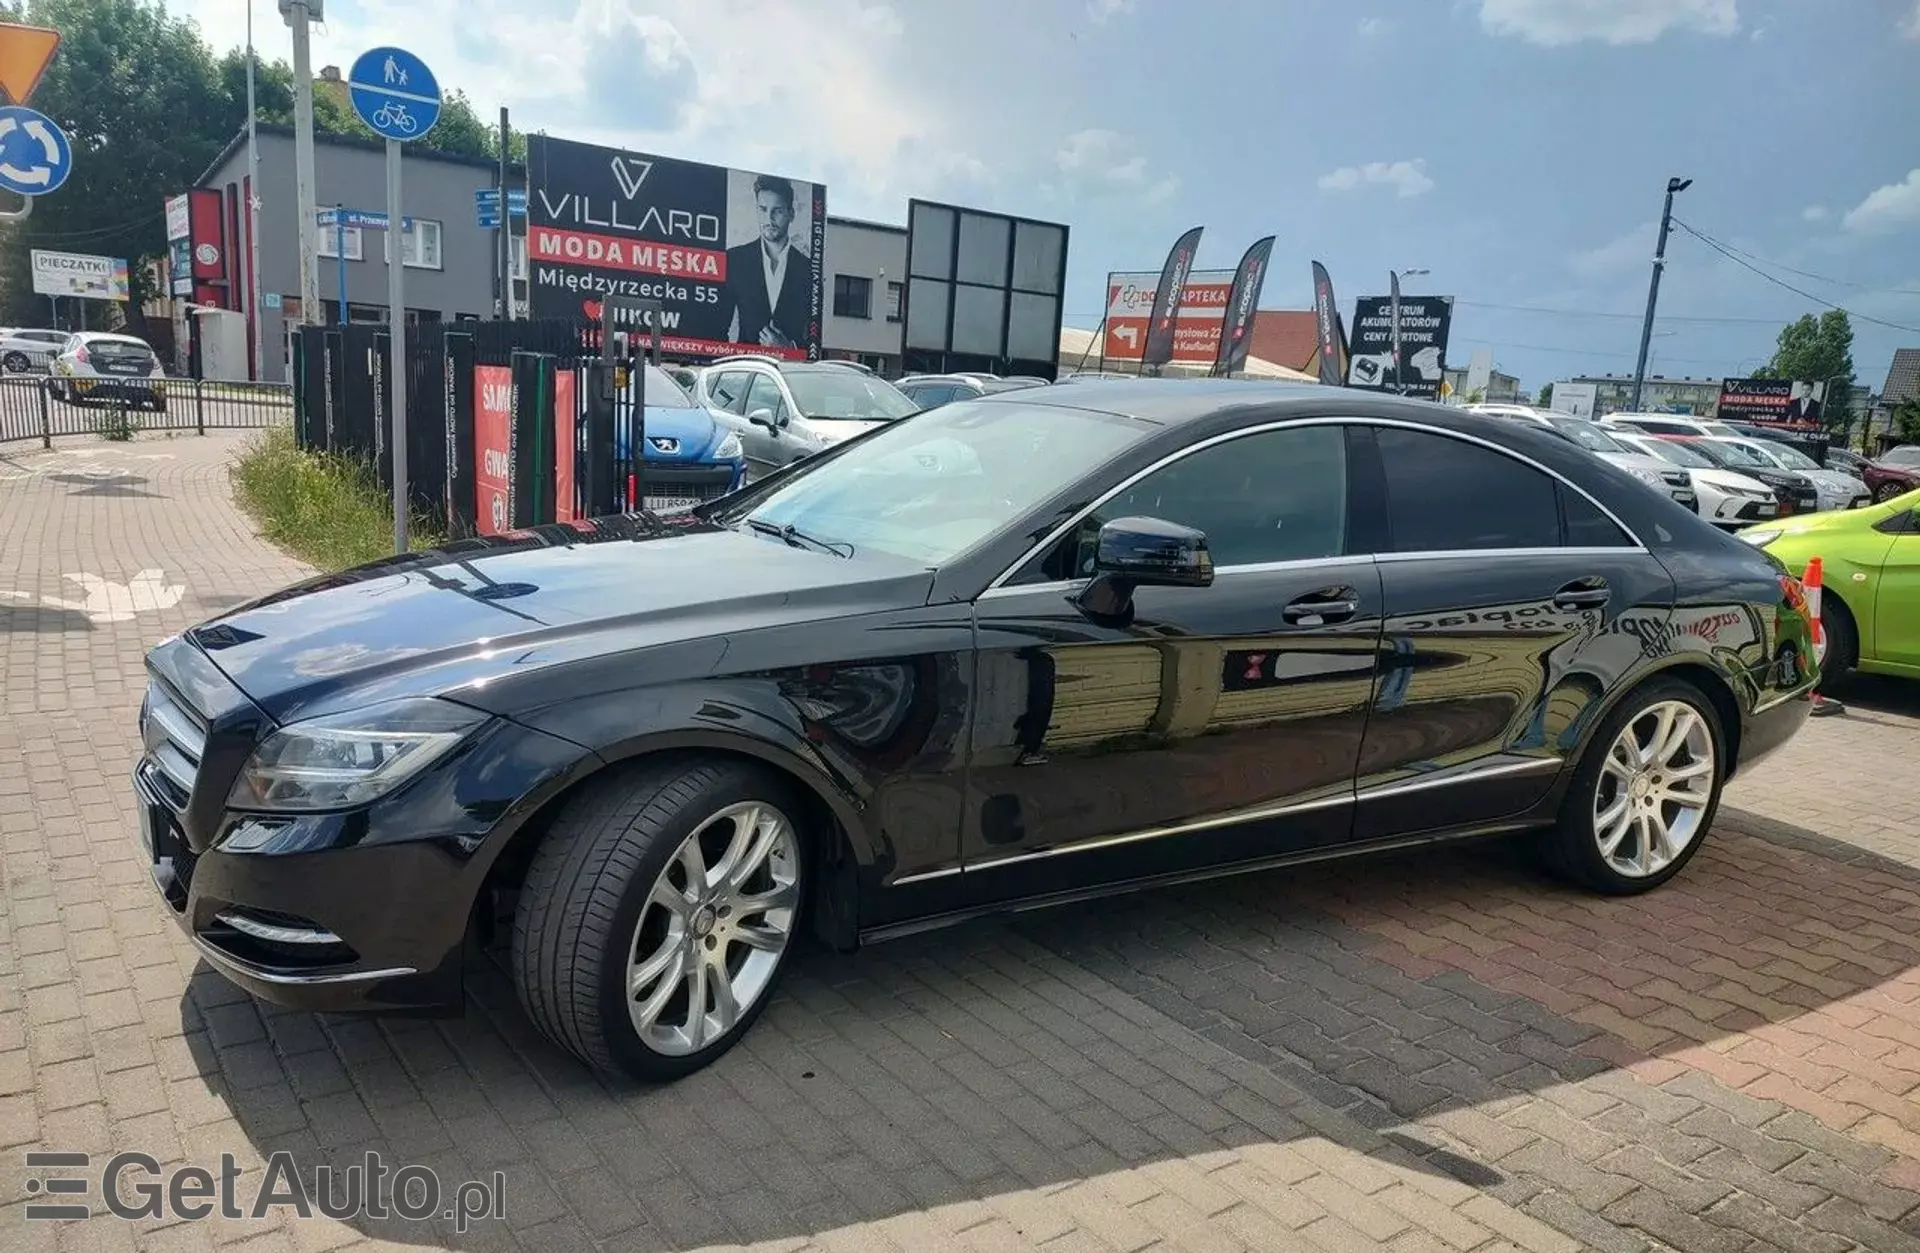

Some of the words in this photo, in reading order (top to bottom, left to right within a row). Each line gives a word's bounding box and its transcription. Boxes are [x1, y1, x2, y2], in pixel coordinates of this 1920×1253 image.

[538, 188, 720, 243] VILLARO
[40, 257, 106, 273] PIECZĄTKI
[539, 232, 624, 264] MODA
[632, 246, 719, 276] MĘSKA
[811, 221, 821, 316] www.villaro.pl
[538, 267, 688, 301] Międzyrzecka
[694, 286, 719, 304] 55
[1378, 304, 1426, 316] CETRUM
[448, 408, 457, 433] MOTO
[511, 384, 520, 431] YANOSIK
[509, 450, 517, 484] MOTO
